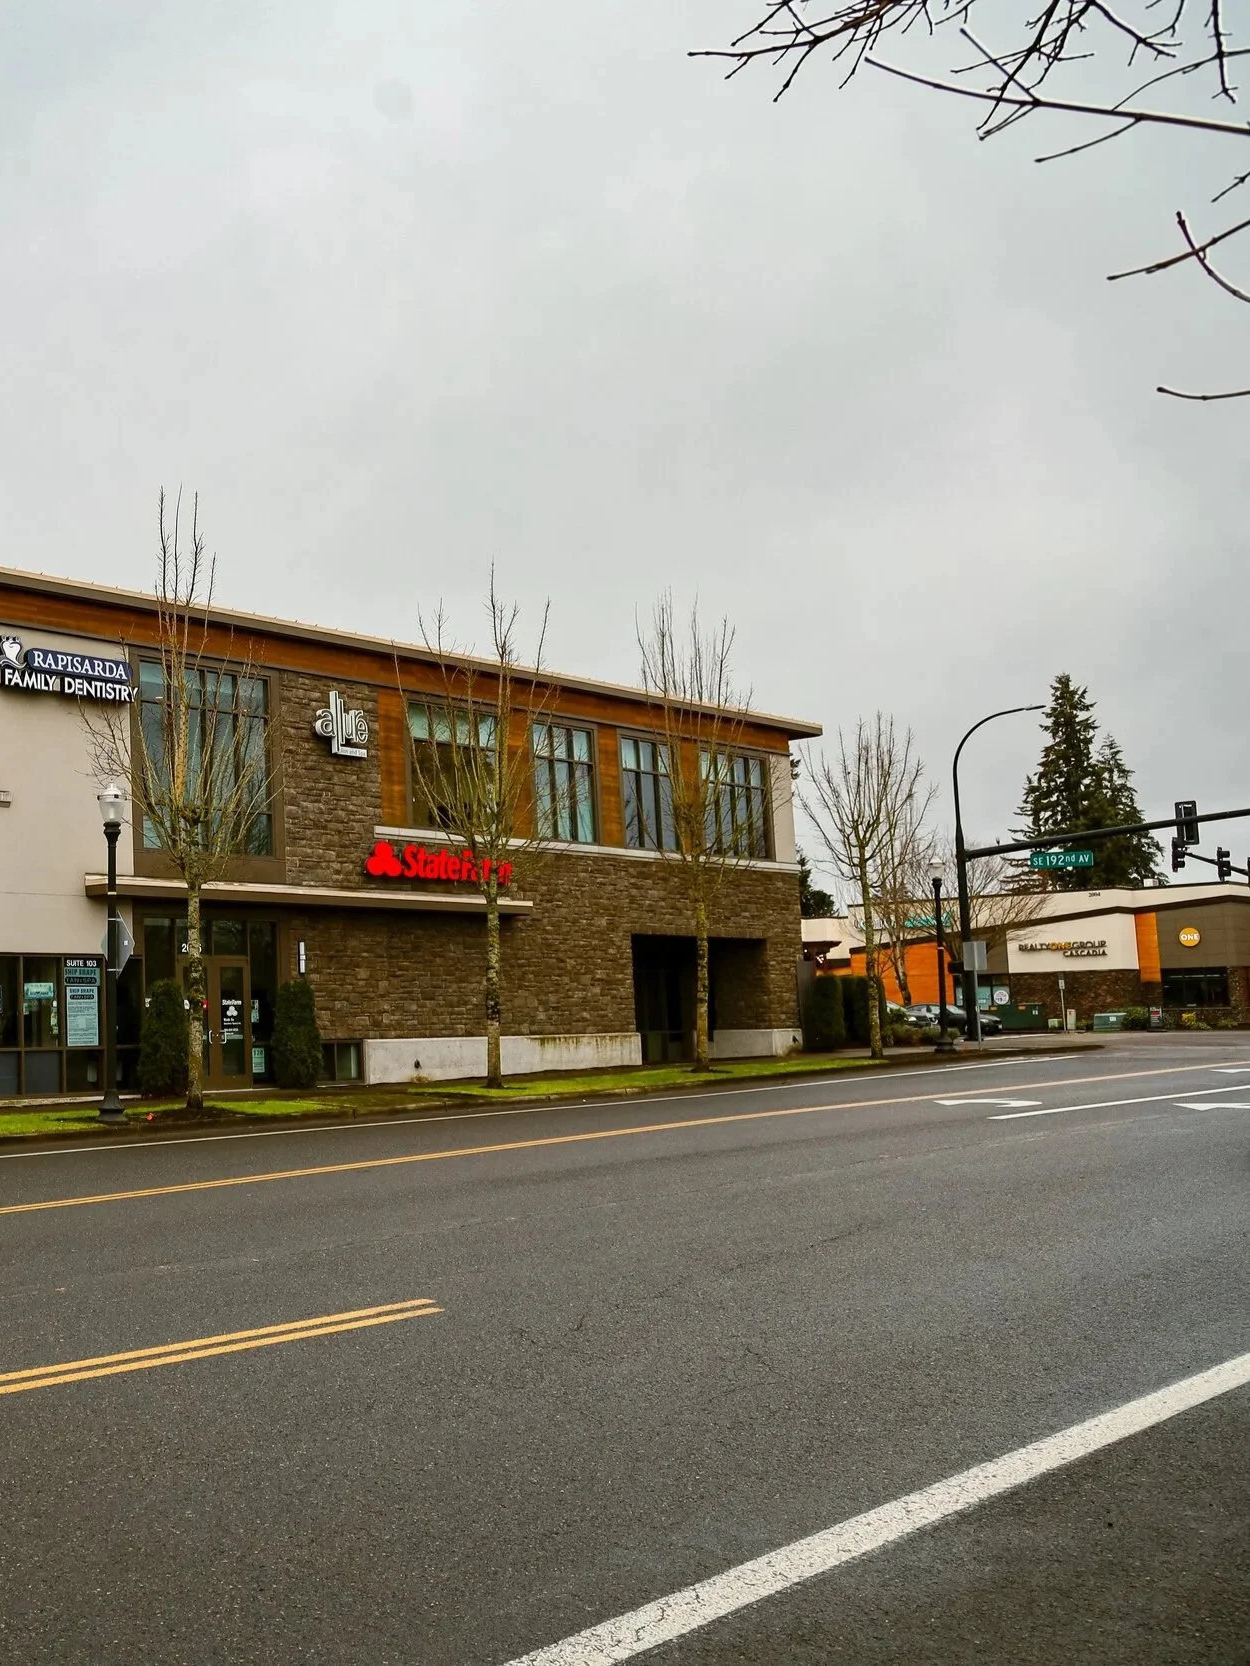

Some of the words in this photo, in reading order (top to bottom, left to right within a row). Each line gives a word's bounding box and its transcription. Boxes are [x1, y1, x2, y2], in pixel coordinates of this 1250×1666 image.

[33, 650, 128, 680] RAPISARDA
[4, 668, 57, 692] FAMILY
[64, 676, 138, 703] DENTISTRY
[315, 690, 368, 753] allure
[1033, 857, 1044, 866] SE
[1046, 854, 1076, 866] 192nd
[1078, 854, 1090, 863] AV
[66, 959, 85, 968] SUITE
[86, 960, 97, 968] 103
[1063, 949, 1108, 958] CASCADIA
